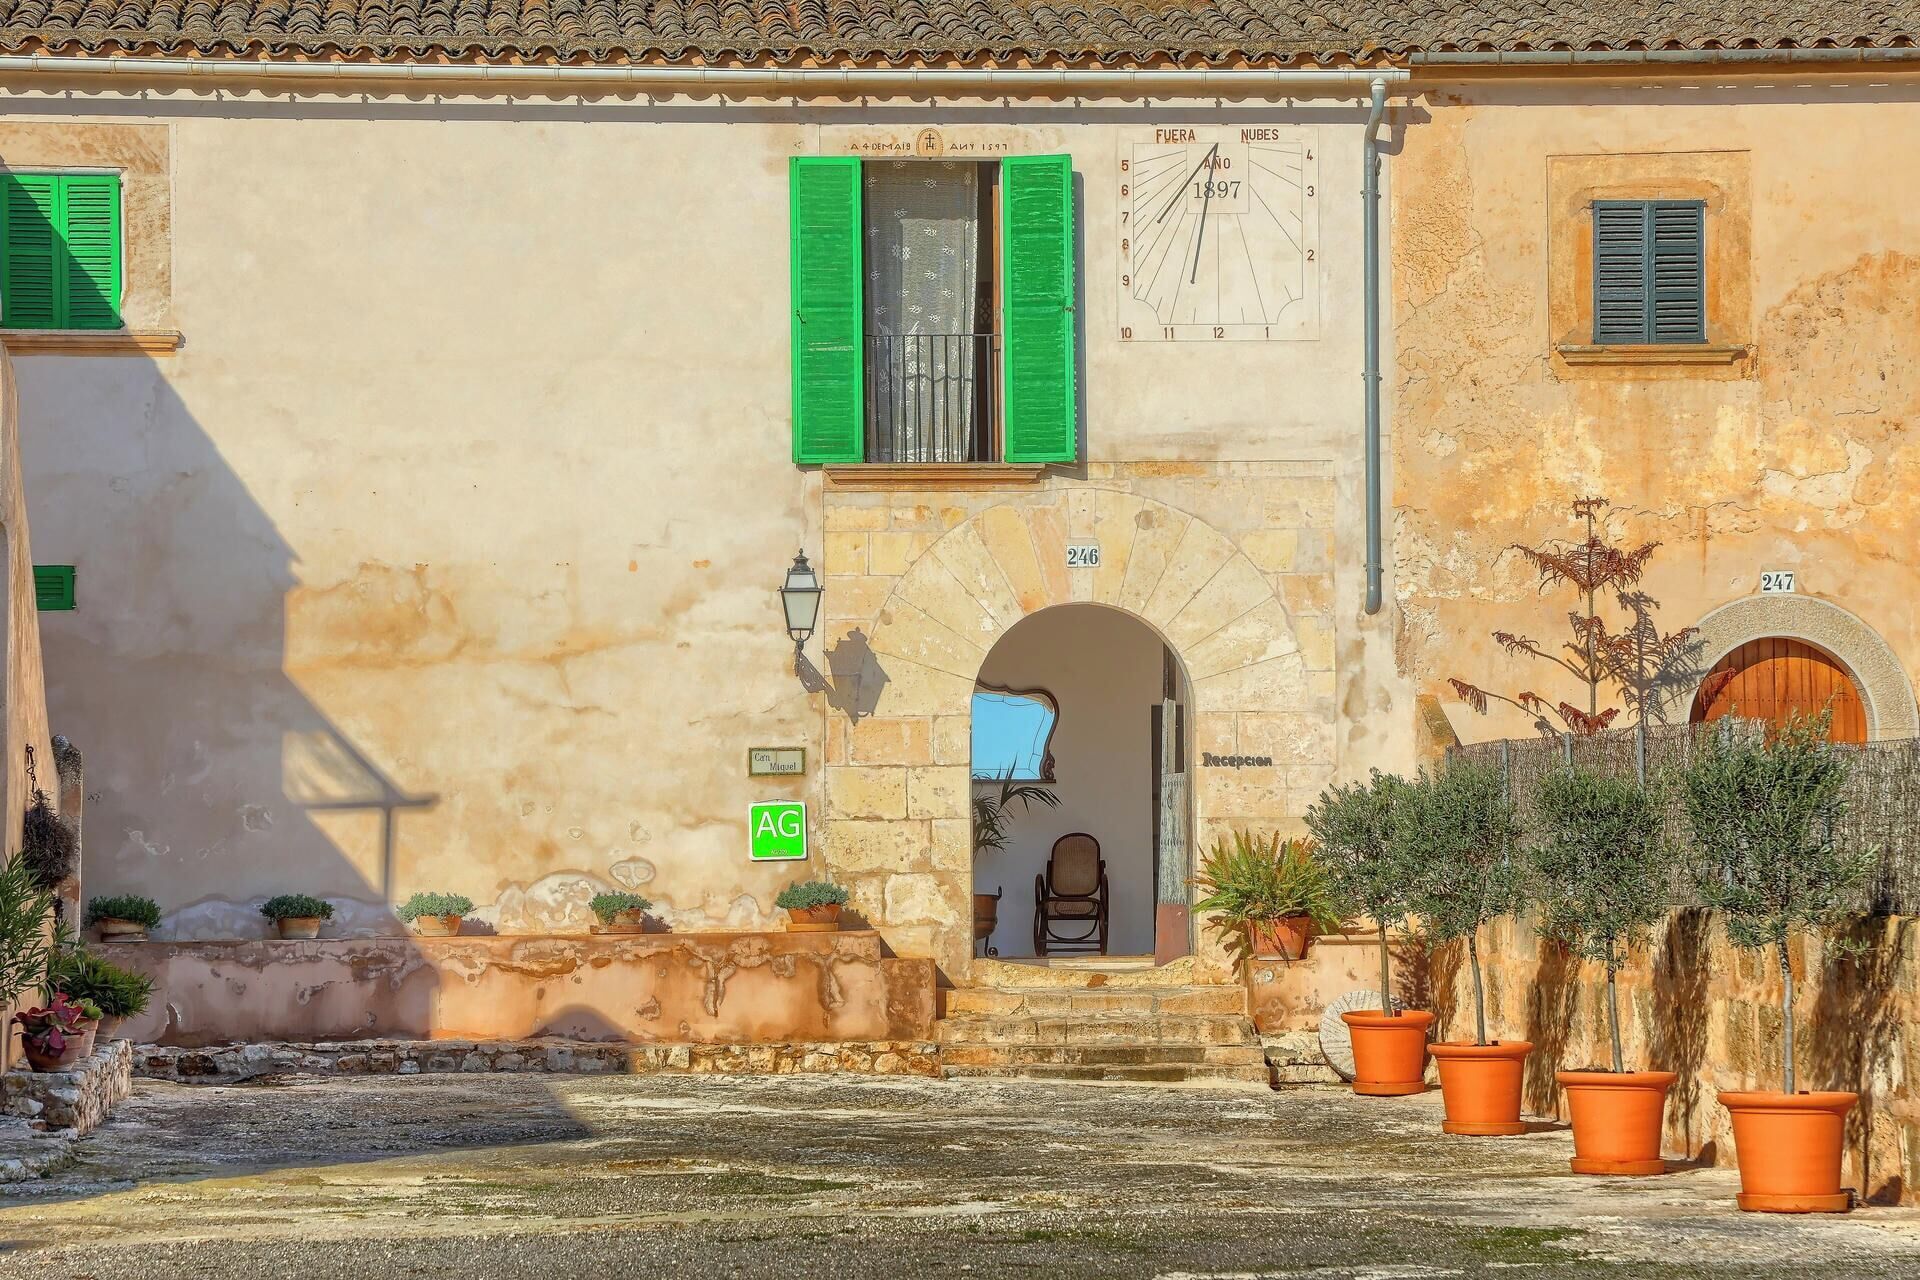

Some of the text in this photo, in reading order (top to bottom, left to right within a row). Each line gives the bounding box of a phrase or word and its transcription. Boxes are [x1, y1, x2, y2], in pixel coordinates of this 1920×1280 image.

[1156, 129, 1279, 141] FUERA NUBES
[1306, 149, 1313, 161] 4
[1121, 160, 1129, 171] 5
[1204, 155, 1231, 169] AÑO
[1121, 184, 1129, 196] 6
[1193, 181, 1241, 199] 1897
[1307, 186, 1315, 197] 3
[1121, 212, 1129, 223] 7
[1121, 238, 1129, 249] 8
[1307, 249, 1315, 261] 2
[1122, 275, 1130, 286] 9
[1121, 327, 1132, 338] 10
[1164, 327, 1174, 338] 11
[1213, 327, 1224, 338] 12
[1067, 548, 1098, 565] 246
[1762, 573, 1794, 591] 247
[756, 810, 800, 838] AG
